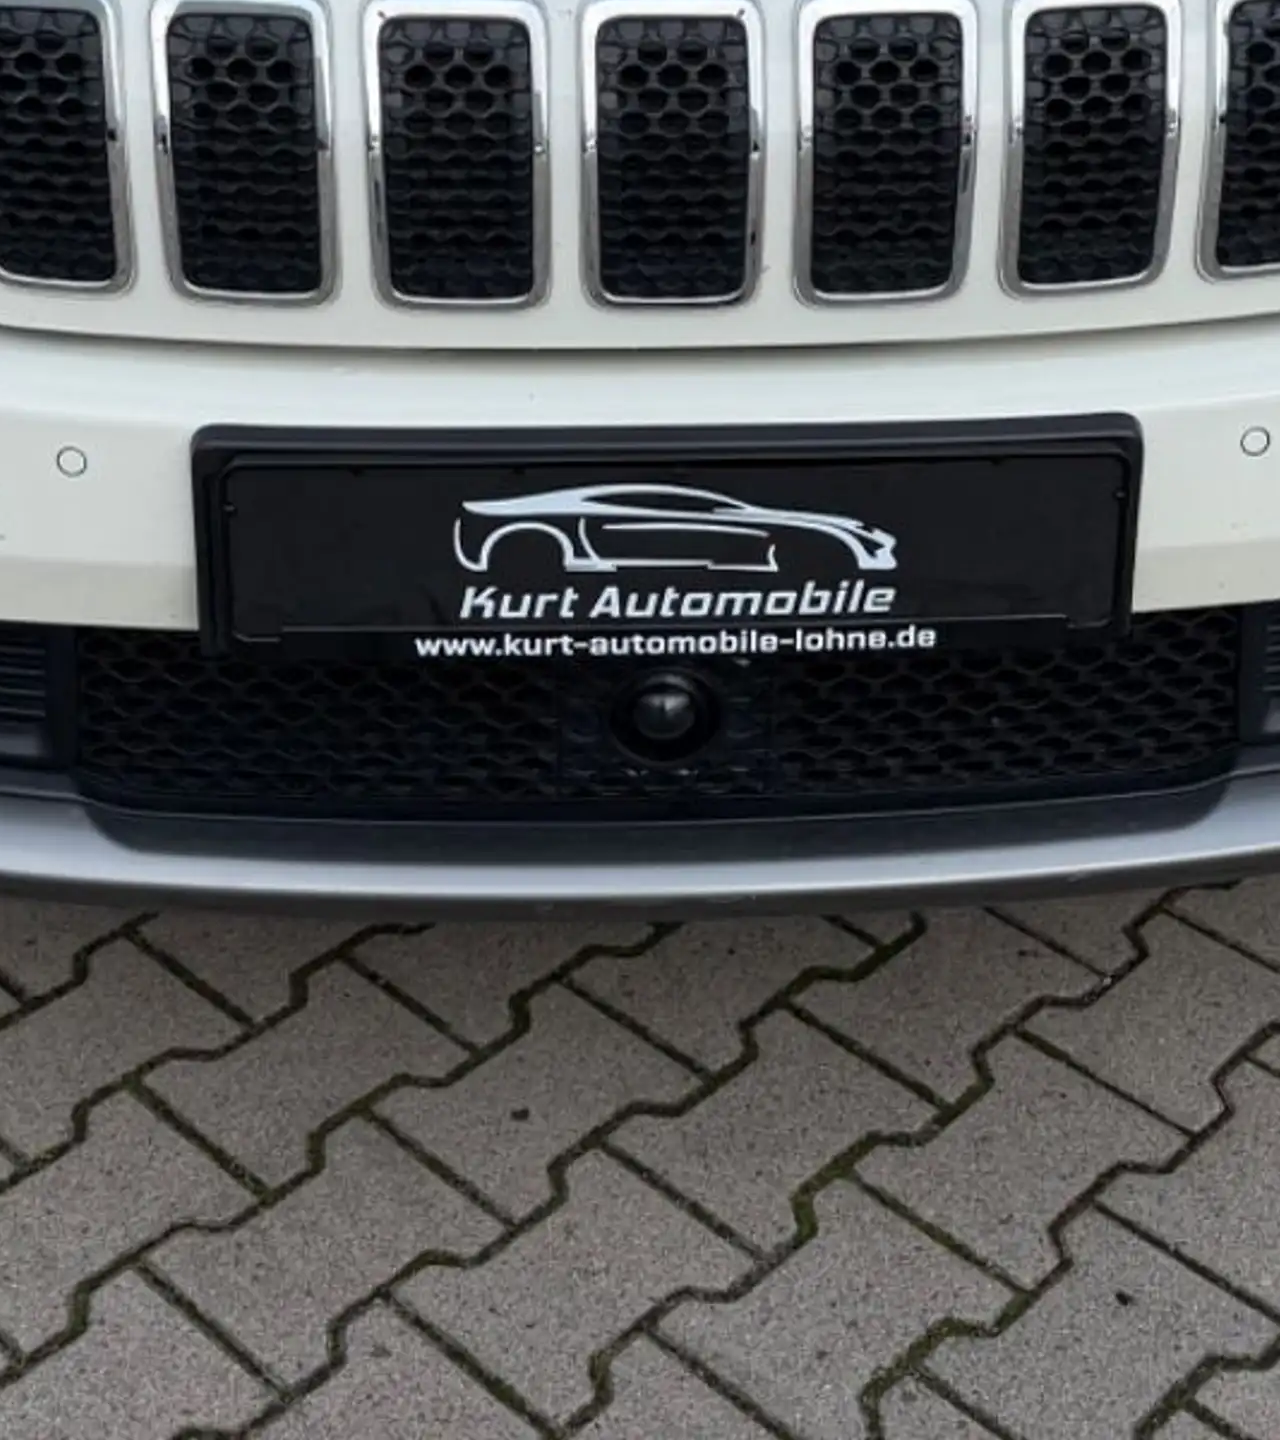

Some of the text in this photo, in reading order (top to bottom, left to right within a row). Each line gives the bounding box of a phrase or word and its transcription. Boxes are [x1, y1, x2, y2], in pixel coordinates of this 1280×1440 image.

[459, 578, 897, 620] Kurt Automobile
[414, 623, 938, 657] www.kurt-automobile-lohne.de
